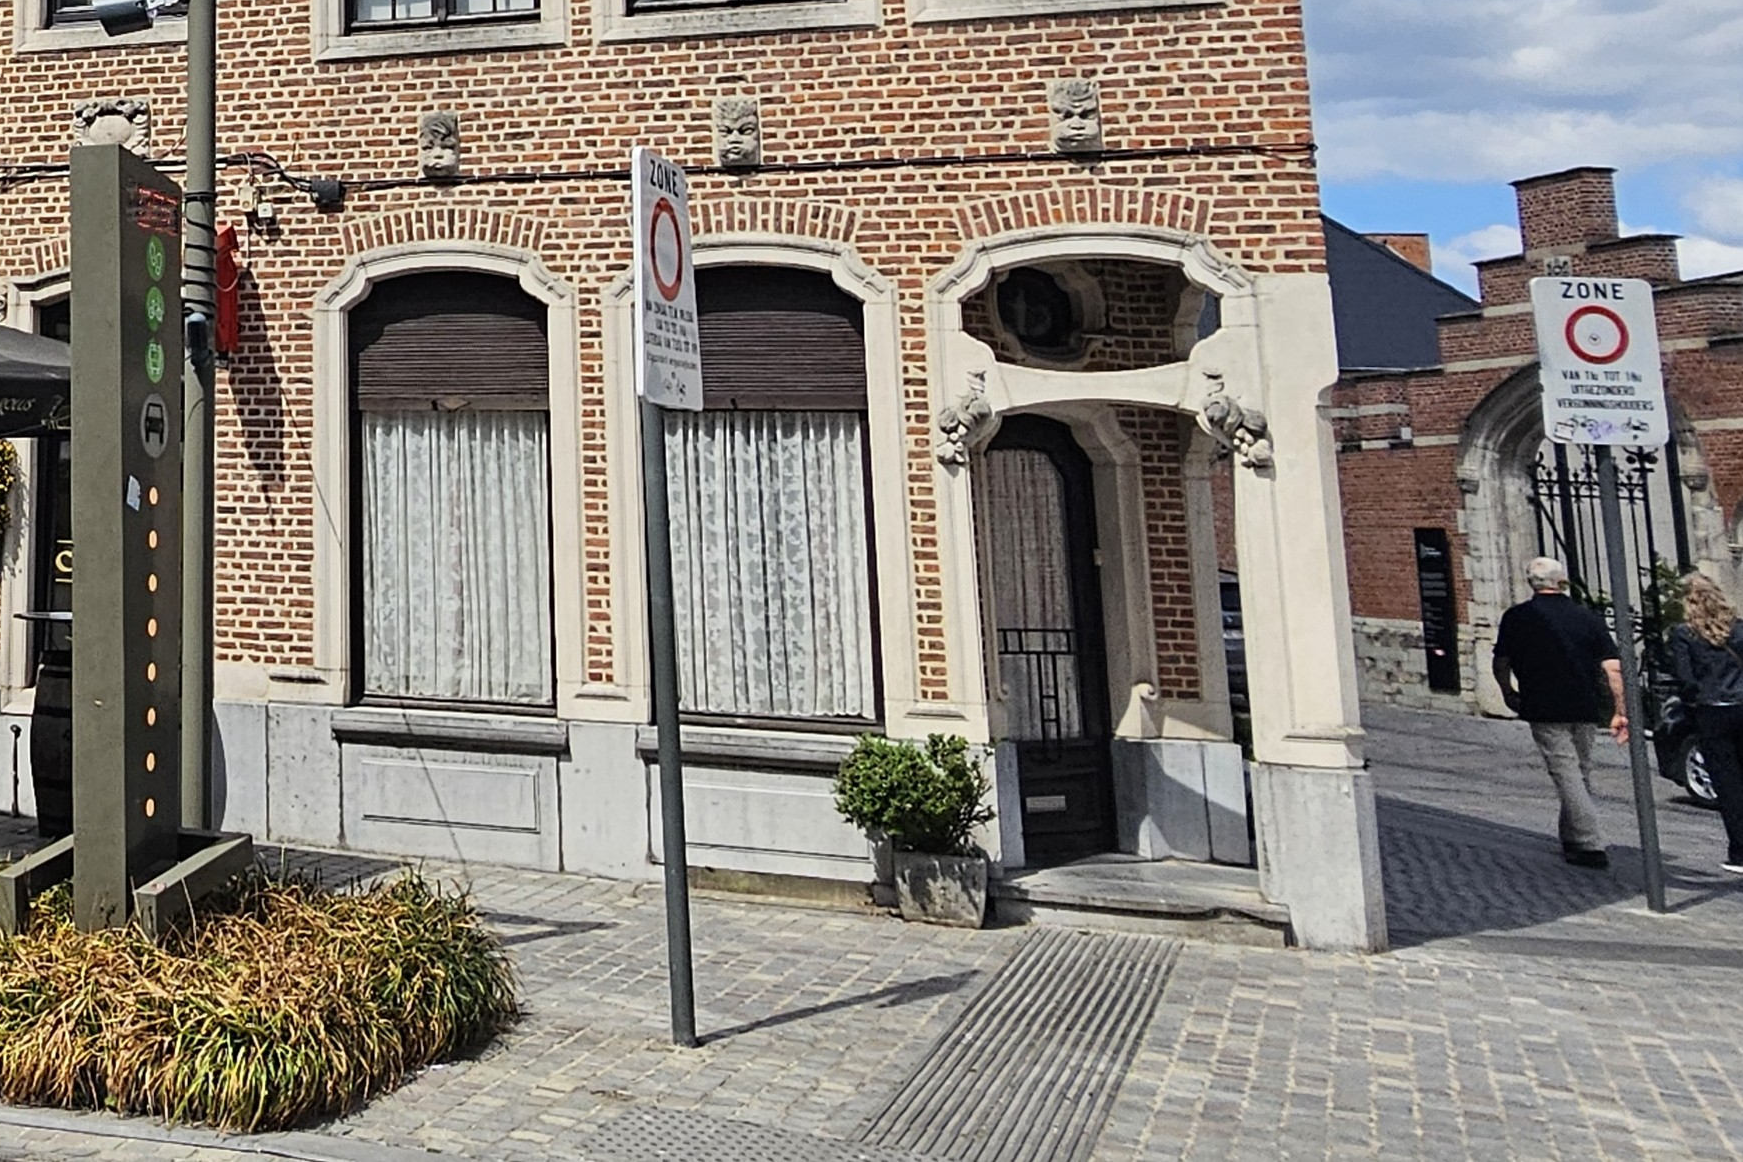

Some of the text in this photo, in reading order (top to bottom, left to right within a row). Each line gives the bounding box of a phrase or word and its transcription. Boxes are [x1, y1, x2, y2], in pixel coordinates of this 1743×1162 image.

[649, 158, 680, 199] ZONE
[1560, 281, 1625, 301] ZONE
[1560, 369, 1580, 381] VAN
[1603, 370, 1621, 382] TOT
